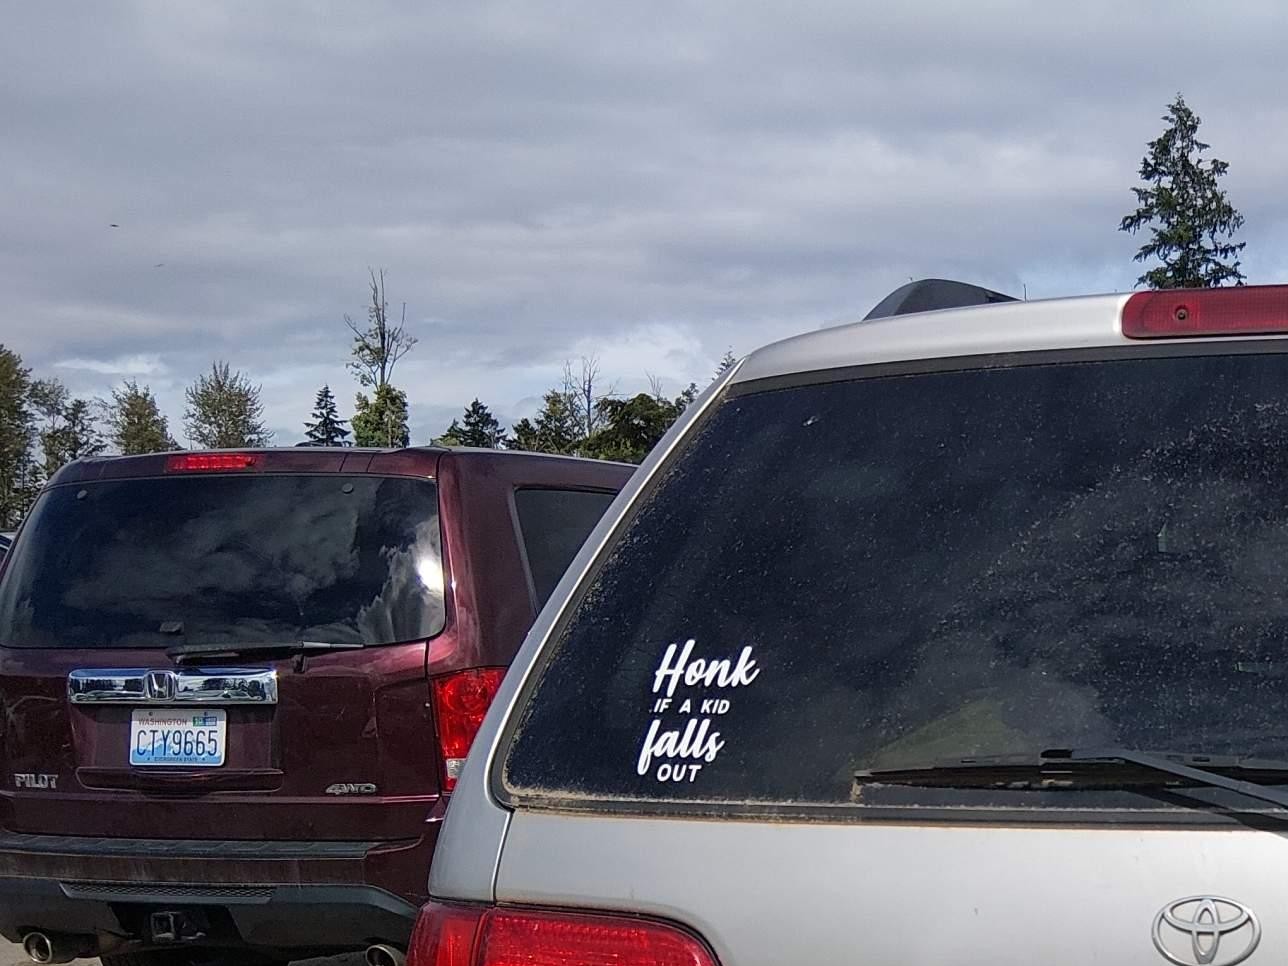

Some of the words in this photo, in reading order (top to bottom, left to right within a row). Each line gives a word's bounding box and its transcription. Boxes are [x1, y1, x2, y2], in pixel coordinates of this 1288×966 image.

[652, 639, 760, 697] Honk
[653, 698, 672, 713] IF
[679, 699, 691, 713] A
[700, 699, 730, 714] KID
[138, 718, 187, 726] WASHINGTON
[136, 729, 218, 756] CTY9665
[637, 718, 725, 776] falls
[14, 773, 59, 789] PILOT
[656, 764, 702, 782] OUT
